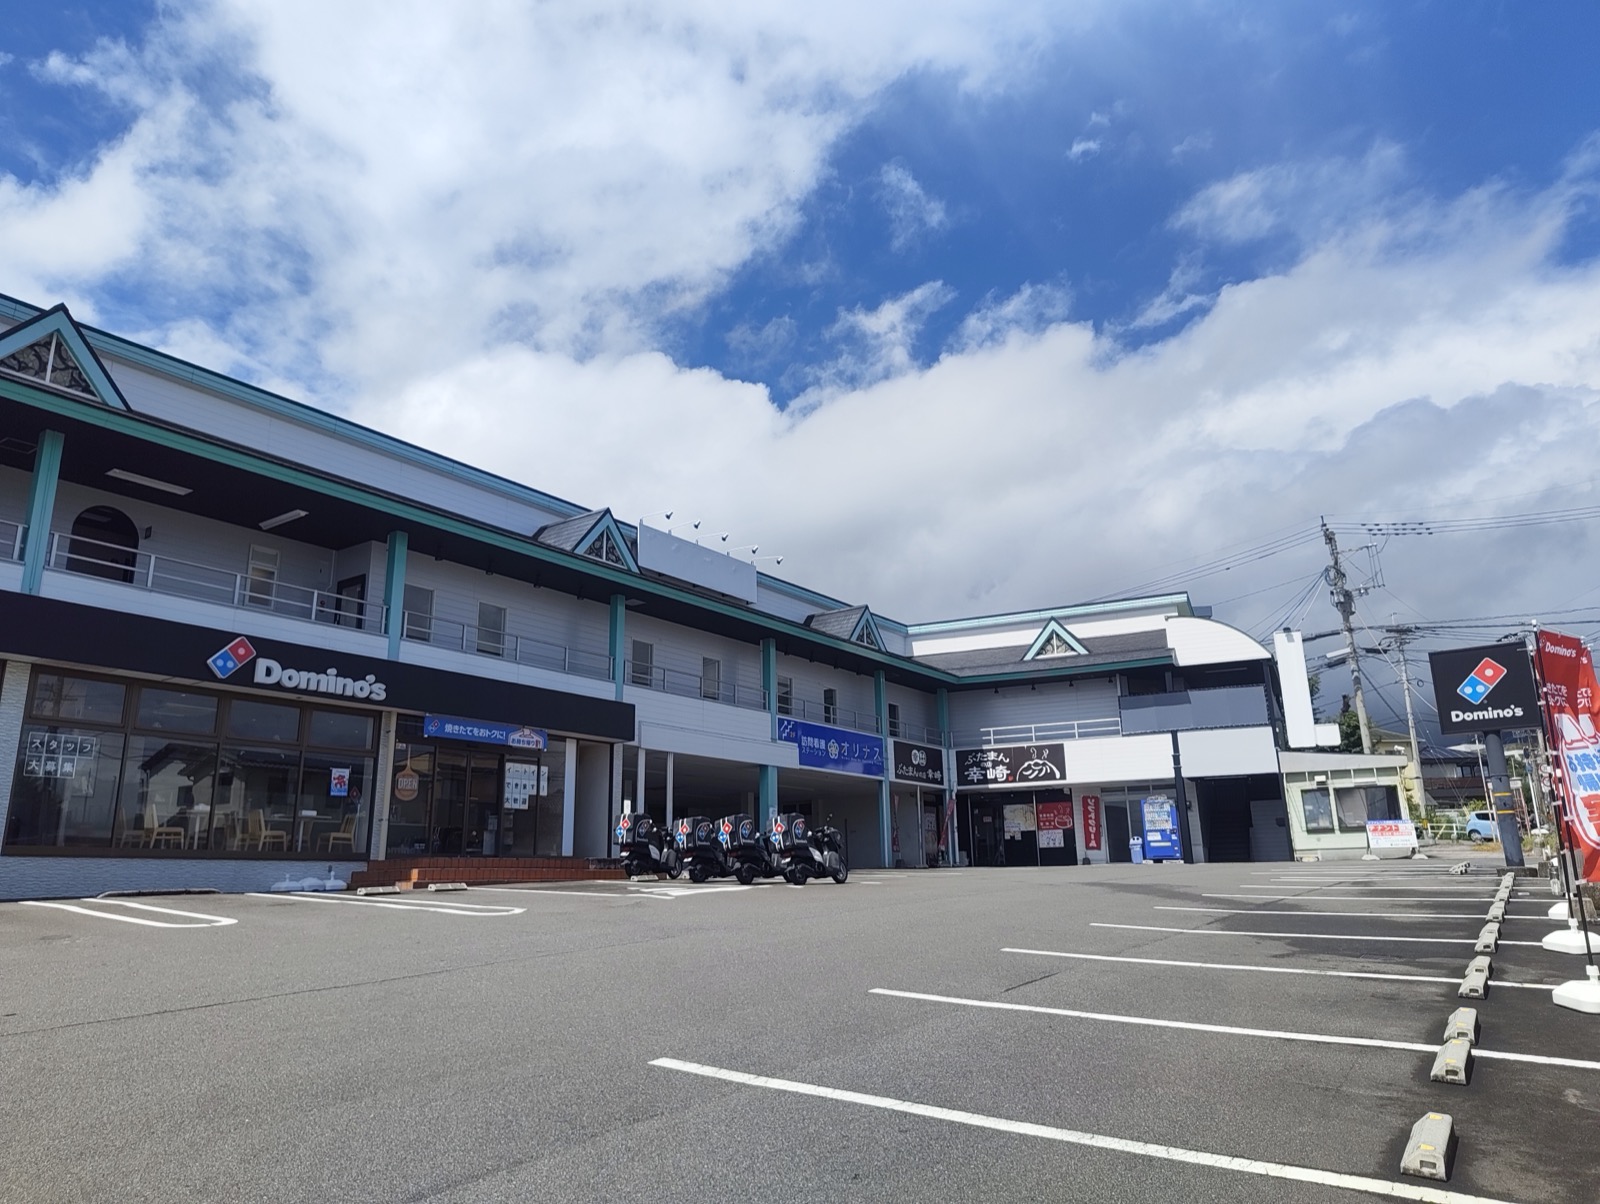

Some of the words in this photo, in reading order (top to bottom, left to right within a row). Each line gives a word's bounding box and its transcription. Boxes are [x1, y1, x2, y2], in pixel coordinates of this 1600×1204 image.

[1545, 642, 1577, 658] Domino's
[254, 657, 387, 702] Domino's
[1450, 704, 1524, 722] Domino's
[444, 722, 506, 742] 焼きたてをおトクに!
[31, 738, 92, 753] スタッフ
[841, 741, 881, 761] オリナス
[27, 760, 74, 773] 大募集
[964, 750, 1010, 766] ぶたまん
[964, 764, 1011, 783] 幸崎
[398, 778, 417, 790] OPEN
